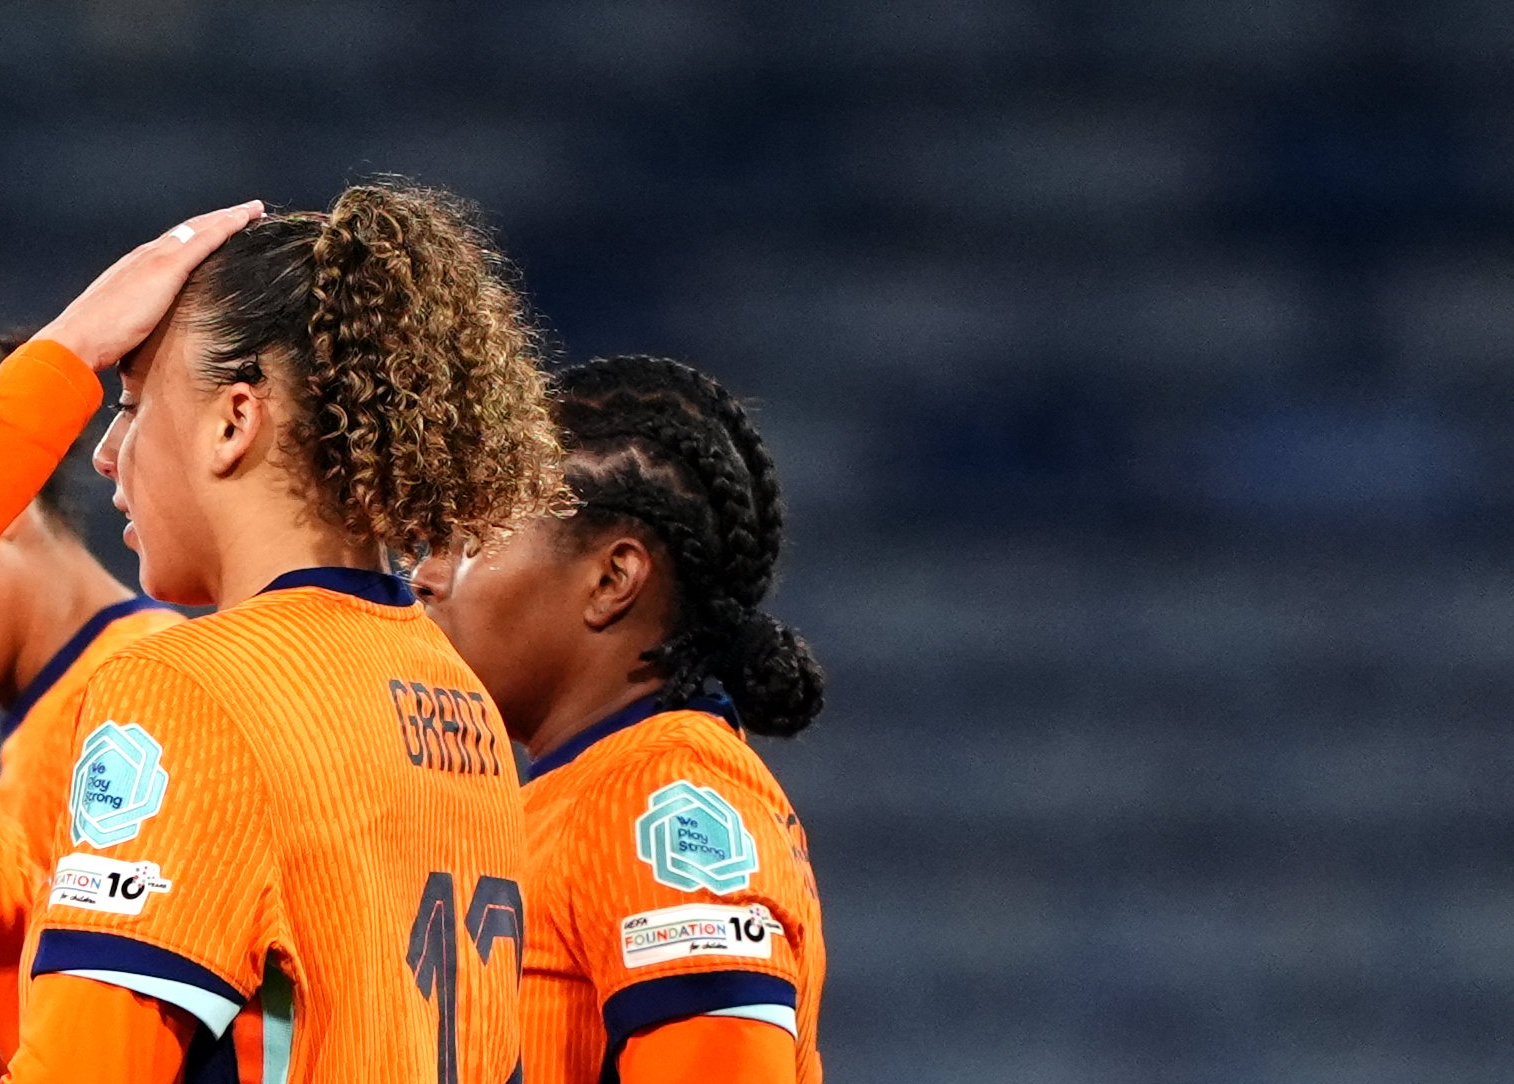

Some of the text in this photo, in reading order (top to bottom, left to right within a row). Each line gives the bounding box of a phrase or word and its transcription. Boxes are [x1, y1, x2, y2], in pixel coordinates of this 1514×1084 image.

[388, 679, 500, 776] GRANT
[677, 816, 698, 828] We
[107, 872, 146, 900] 10
[624, 917, 648, 930] UEFA
[624, 923, 727, 949] FOUNDATION
[729, 917, 765, 942] 10
